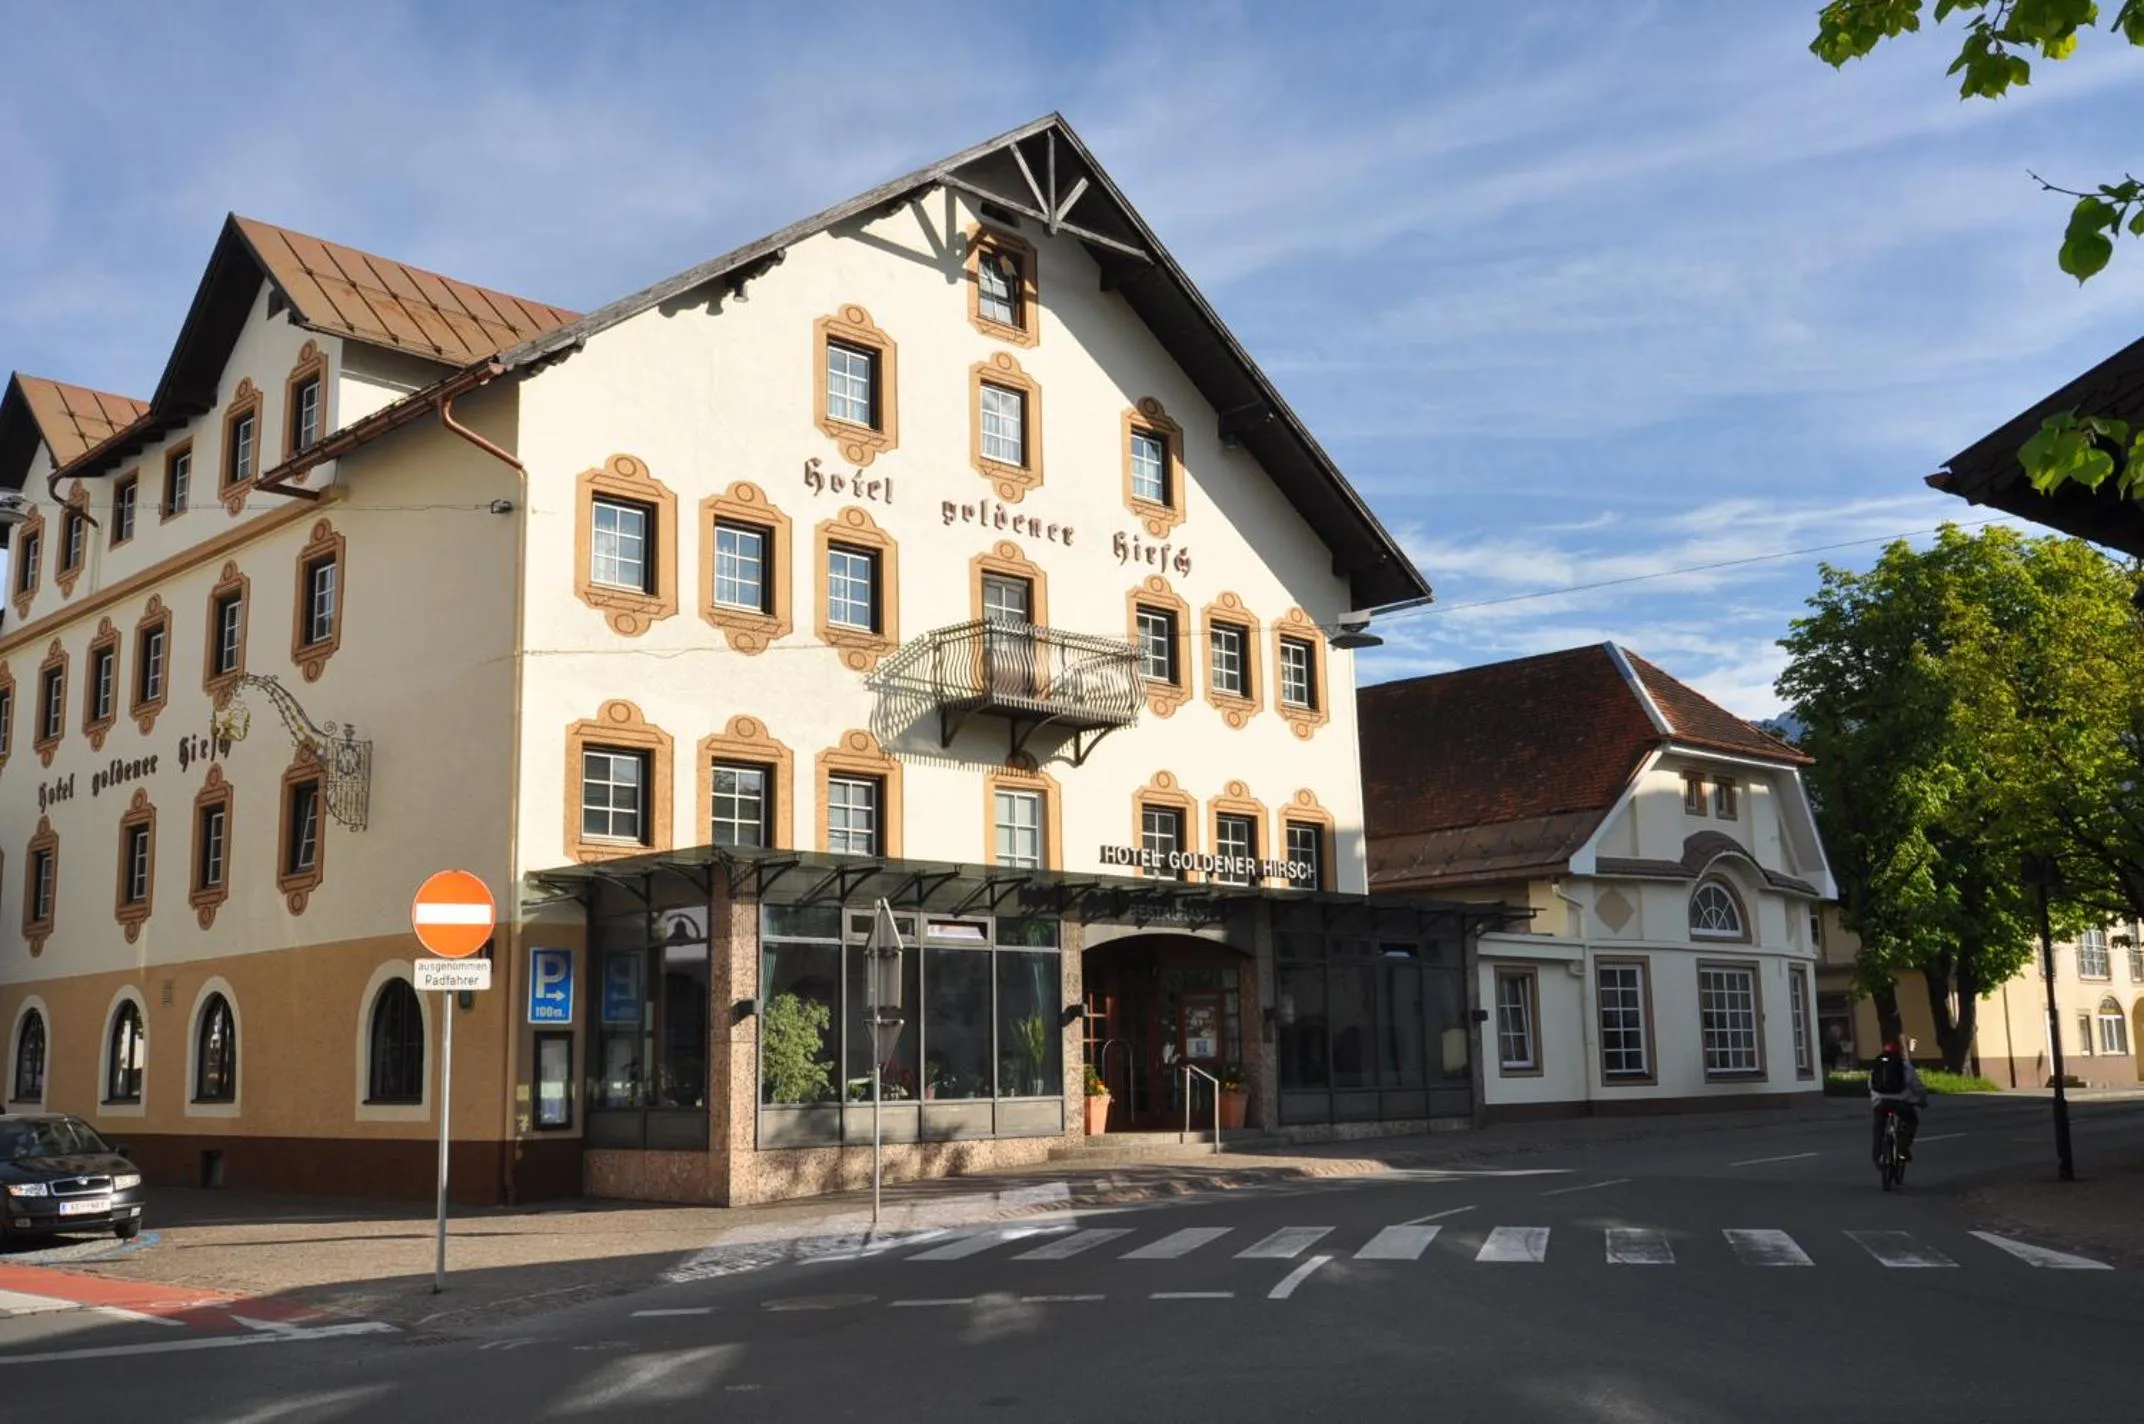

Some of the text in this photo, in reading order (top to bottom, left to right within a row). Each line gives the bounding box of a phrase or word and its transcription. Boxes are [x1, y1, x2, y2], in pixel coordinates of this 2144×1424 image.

[804, 457, 1193, 578] Hotel goldener Hirsch
[39, 773, 75, 813] Hotel
[92, 754, 158, 797] goldener
[1104, 846, 1315, 880] HOTEL GOLDENER HIRSCH
[418, 962, 487, 973] ausgenommen
[425, 974, 479, 986] Radfahrer
[535, 954, 567, 999] P
